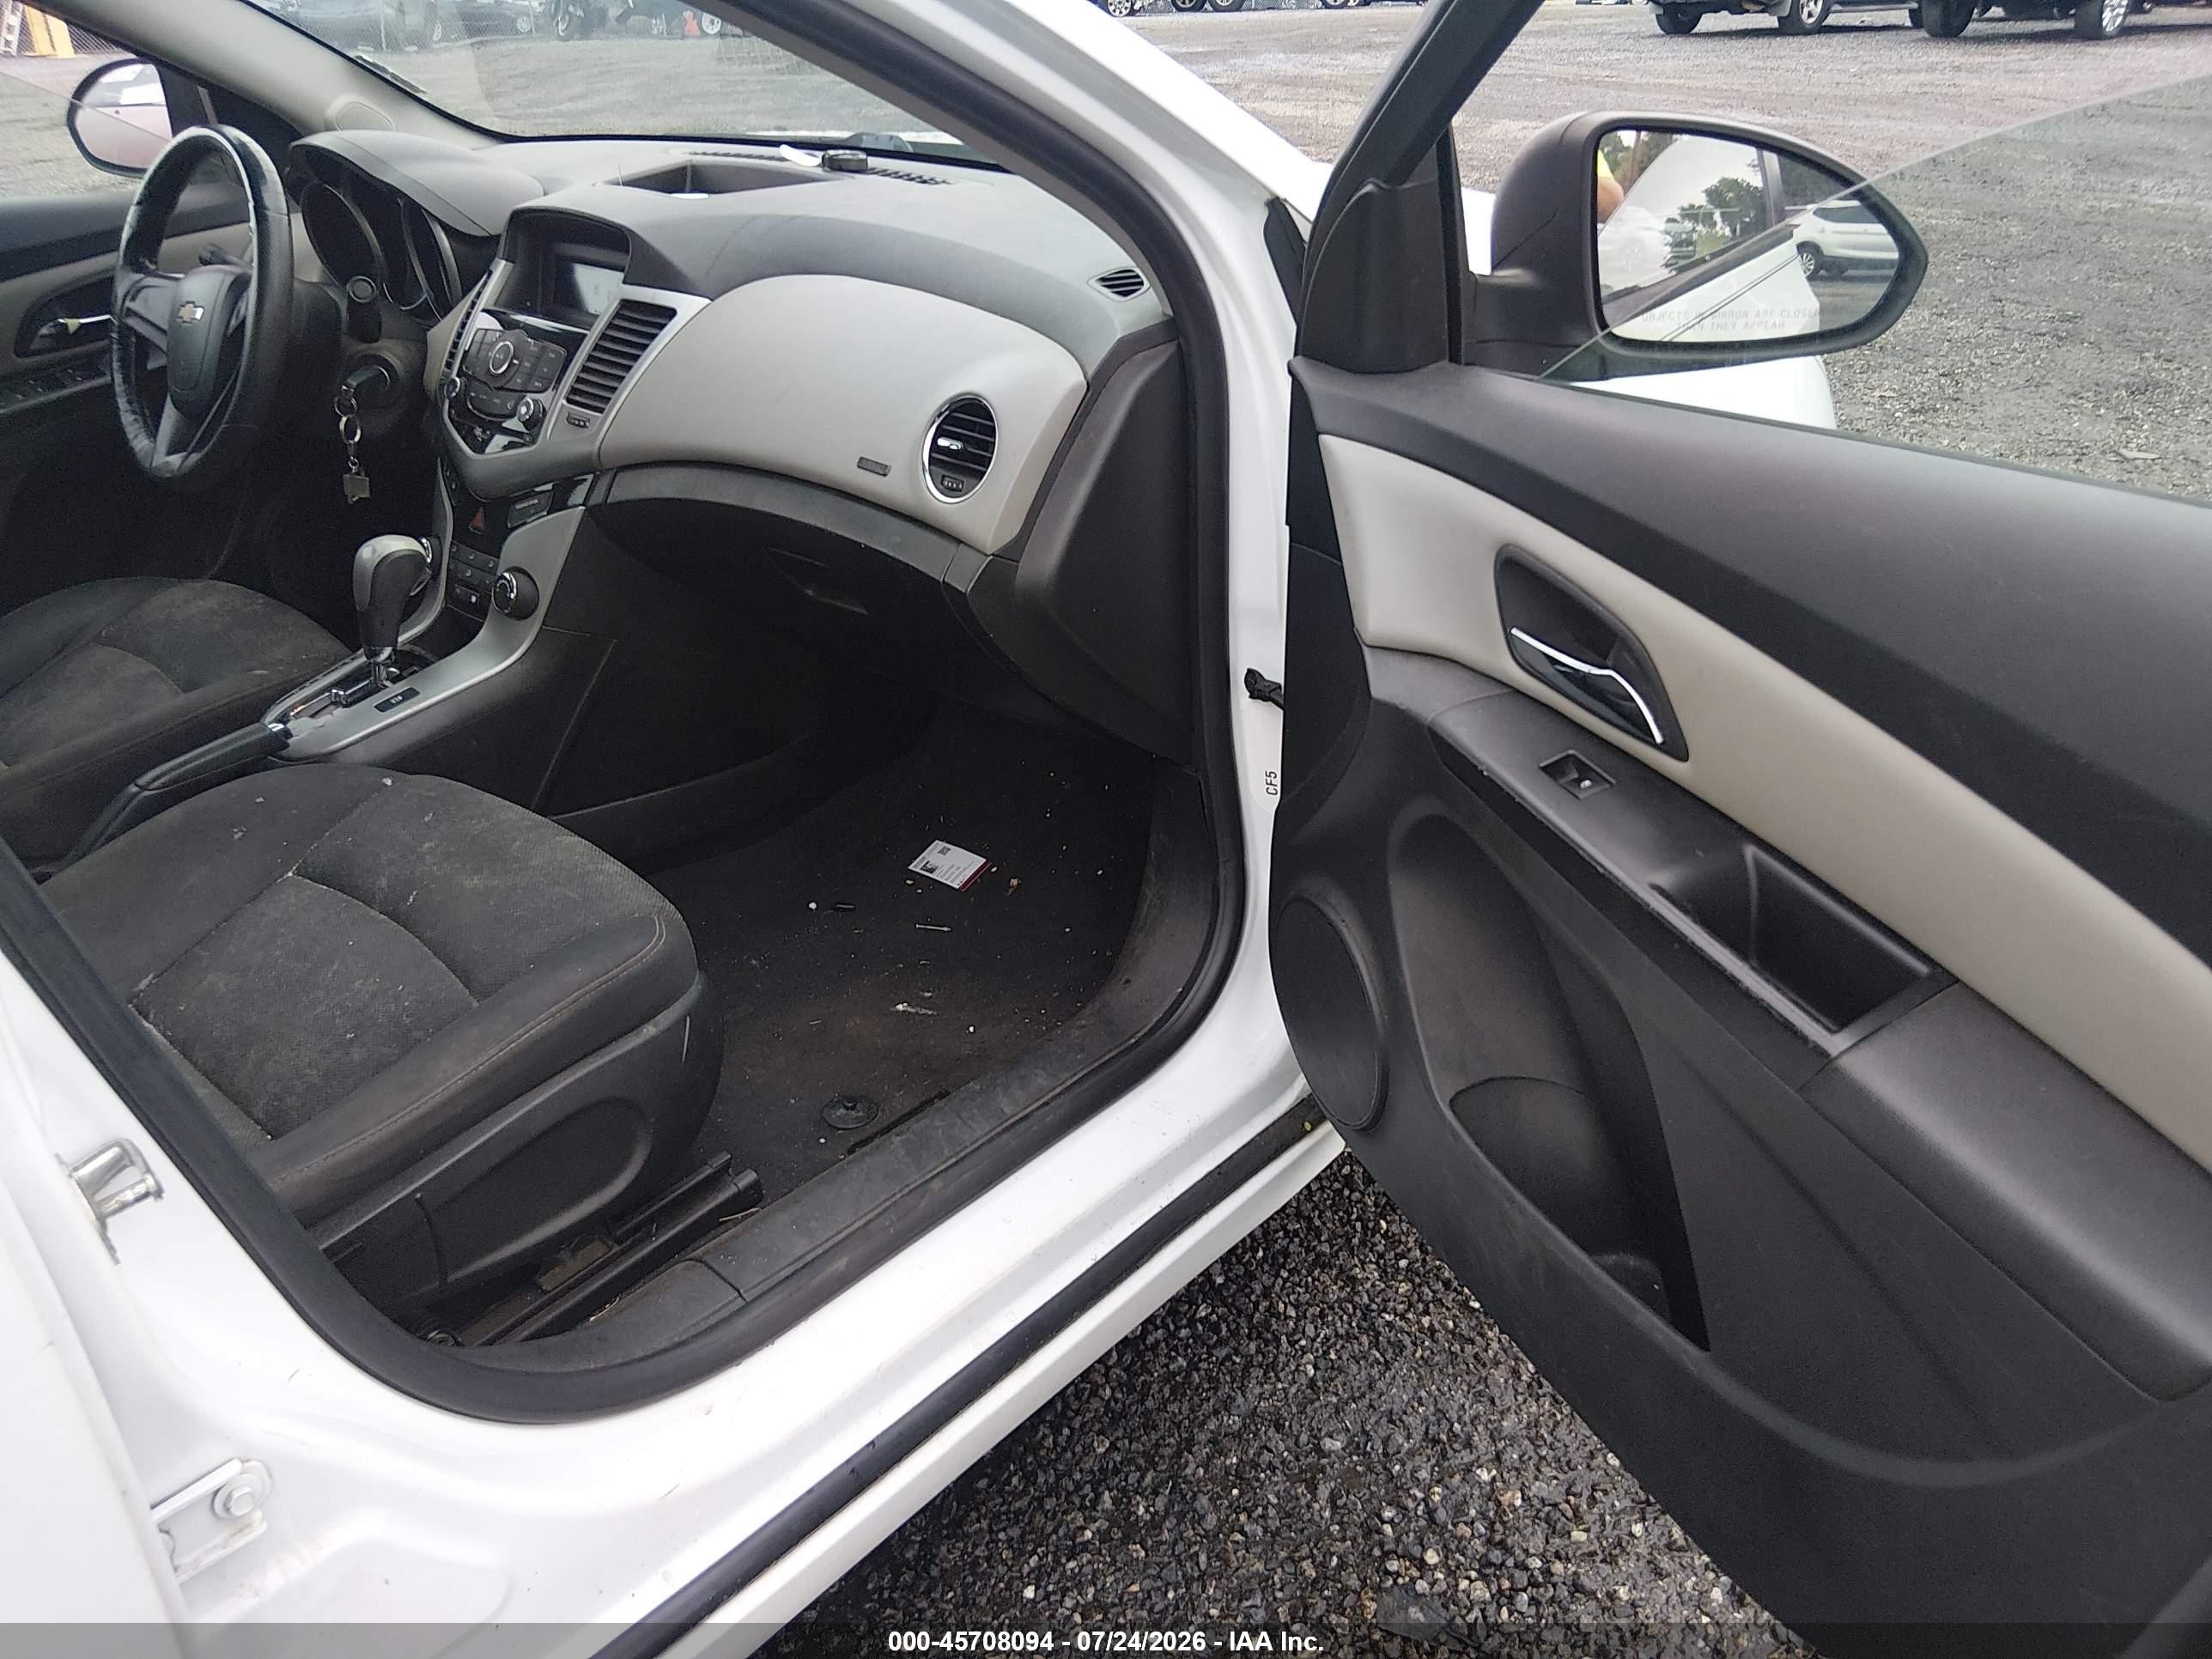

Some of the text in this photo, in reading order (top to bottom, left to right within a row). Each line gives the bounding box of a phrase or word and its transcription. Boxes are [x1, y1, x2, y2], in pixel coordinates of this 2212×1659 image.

[1642, 311, 1691, 322] OBJECTS
[1712, 308, 1748, 320] MIRROR
[1754, 308, 1774, 319] ARE
[1711, 321, 1736, 331] THEY
[1744, 320, 1785, 331] APPEAR
[1265, 770, 1279, 796] CF5
